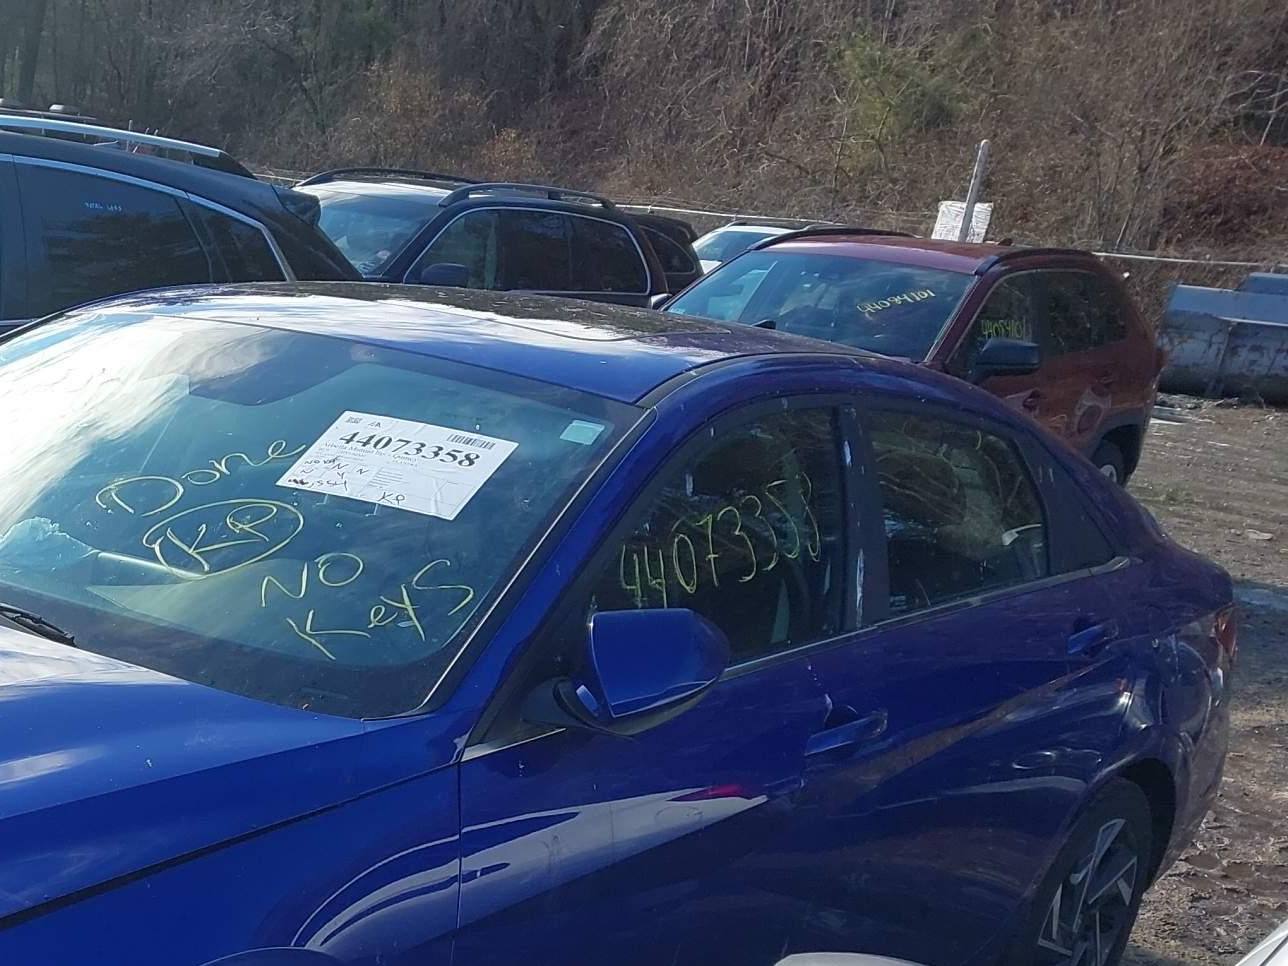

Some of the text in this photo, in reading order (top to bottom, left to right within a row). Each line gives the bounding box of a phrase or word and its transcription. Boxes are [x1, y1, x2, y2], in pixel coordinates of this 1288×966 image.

[95, 439, 306, 516] Done
[339, 431, 476, 467] 44073358
[261, 551, 364, 608] NO
